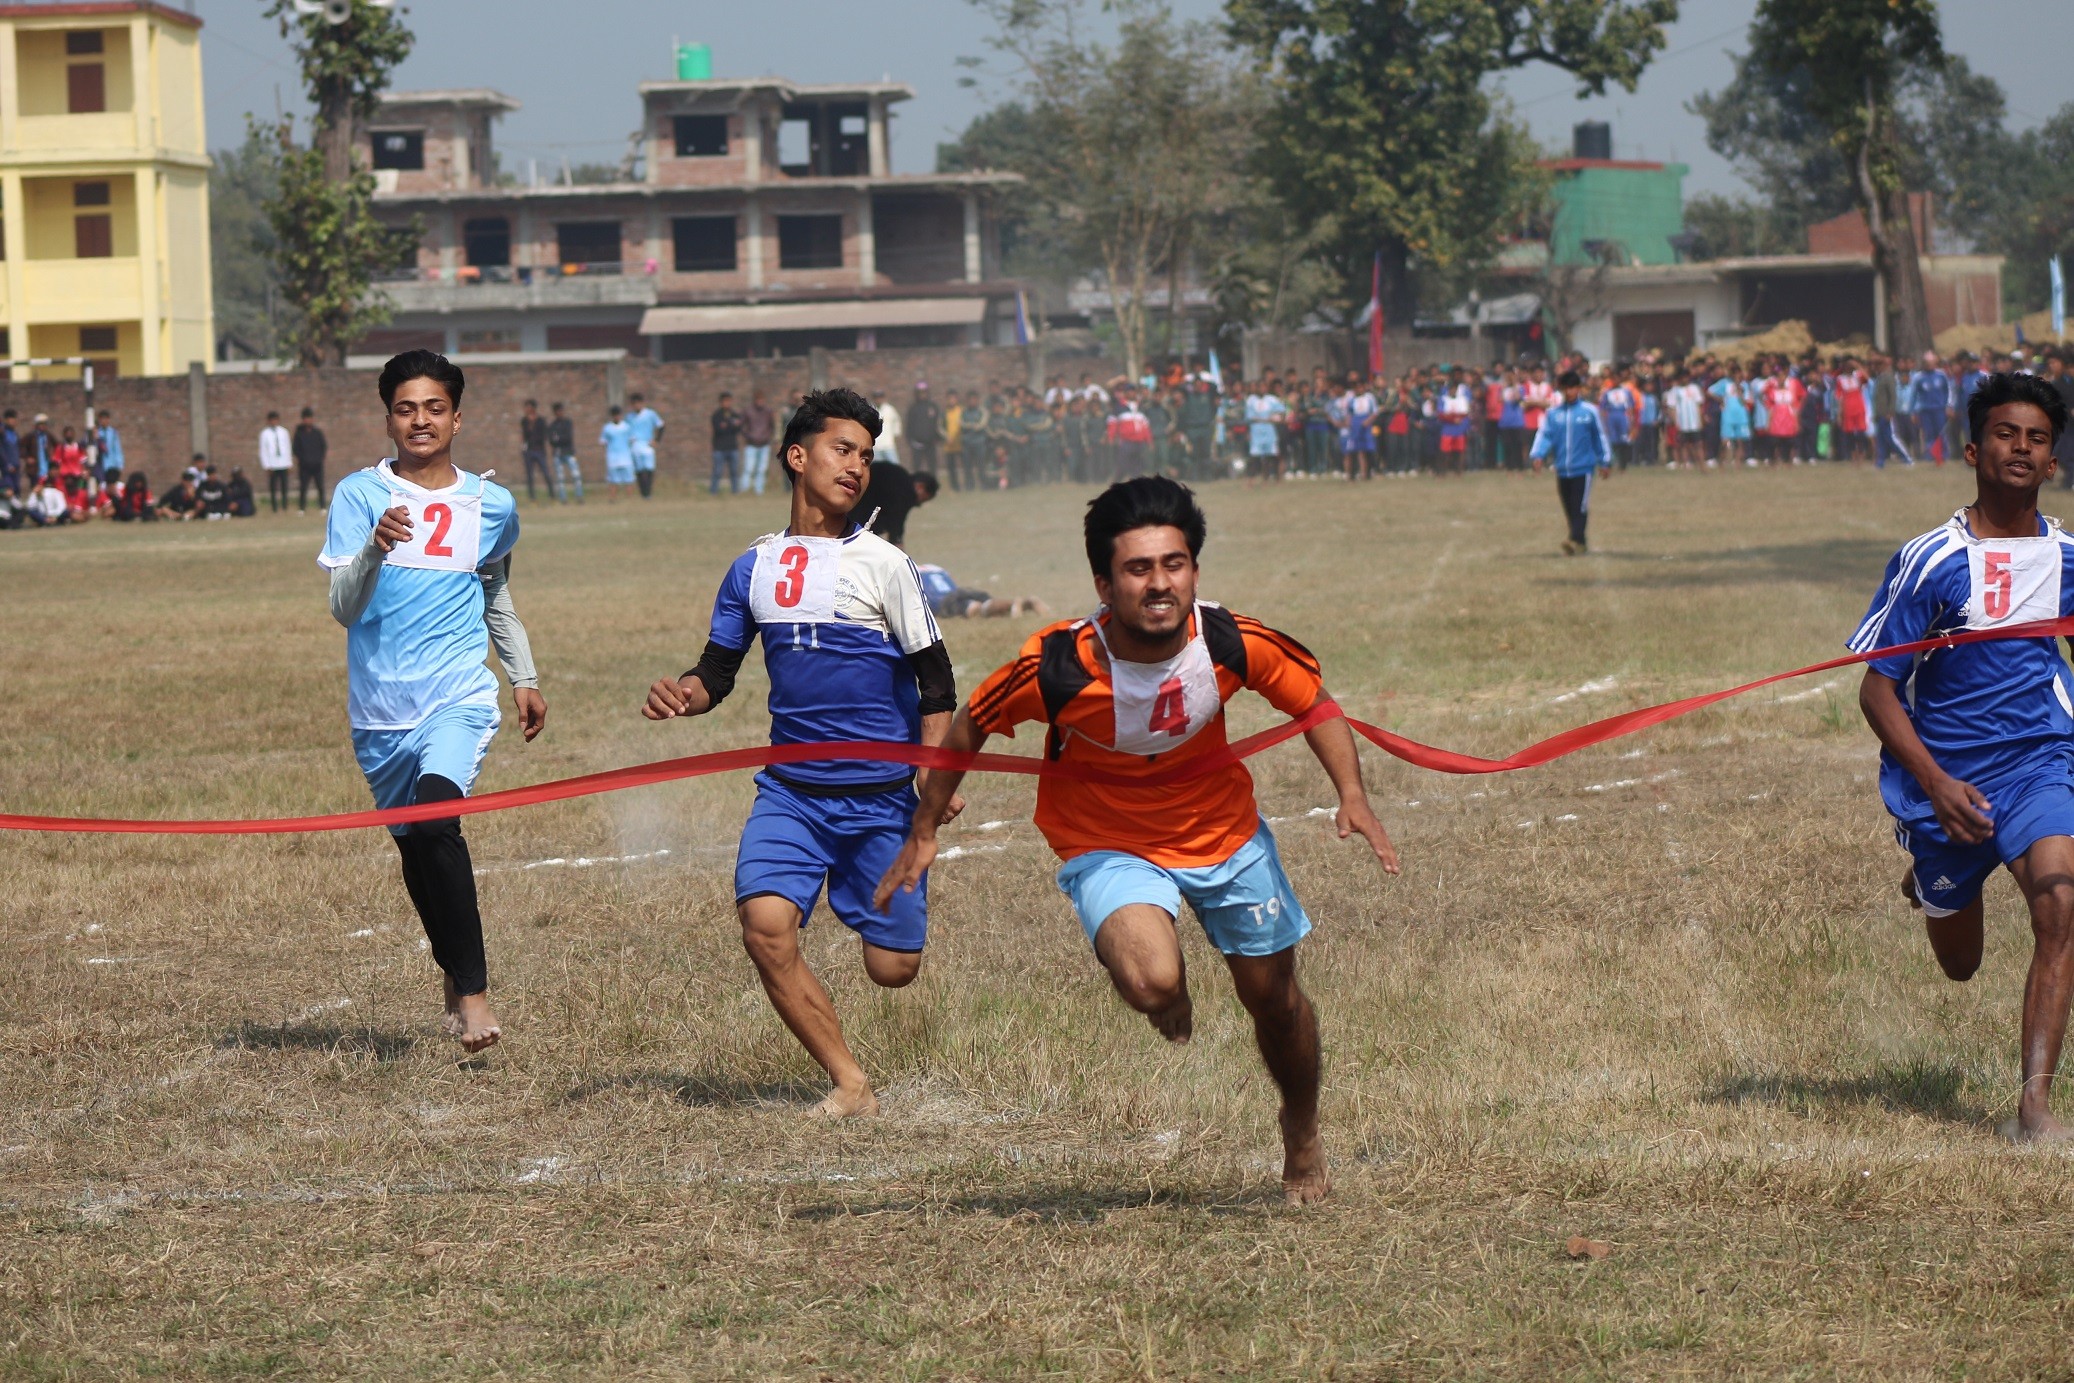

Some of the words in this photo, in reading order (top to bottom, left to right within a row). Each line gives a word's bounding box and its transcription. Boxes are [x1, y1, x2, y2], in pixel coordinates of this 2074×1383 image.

[423, 503, 453, 557] 2
[774, 545, 809, 608] 3
[1984, 552, 2011, 618] 5
[1149, 676, 1191, 737] 4
